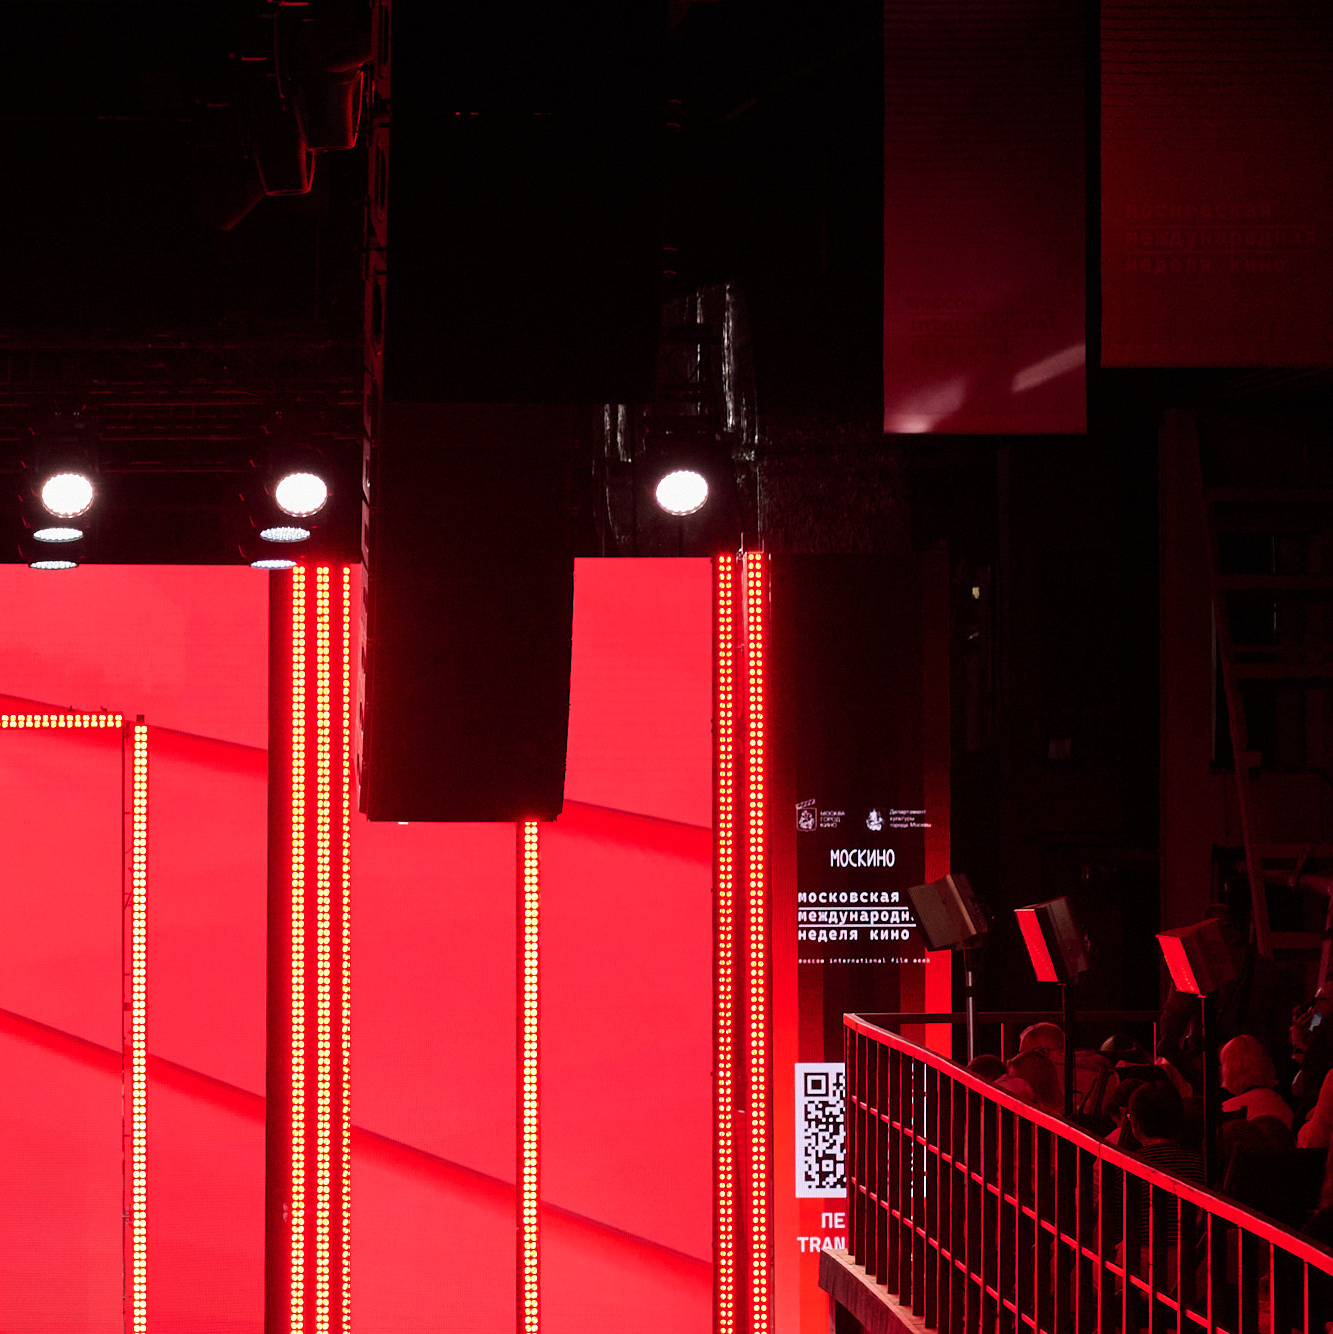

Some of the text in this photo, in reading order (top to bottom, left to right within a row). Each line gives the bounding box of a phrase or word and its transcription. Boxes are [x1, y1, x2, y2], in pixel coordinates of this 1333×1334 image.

[830, 849, 896, 867] МОСКИНО
[797, 891, 900, 903] московская
[797, 910, 915, 925] международн
[797, 928, 910, 942] неделя кино
